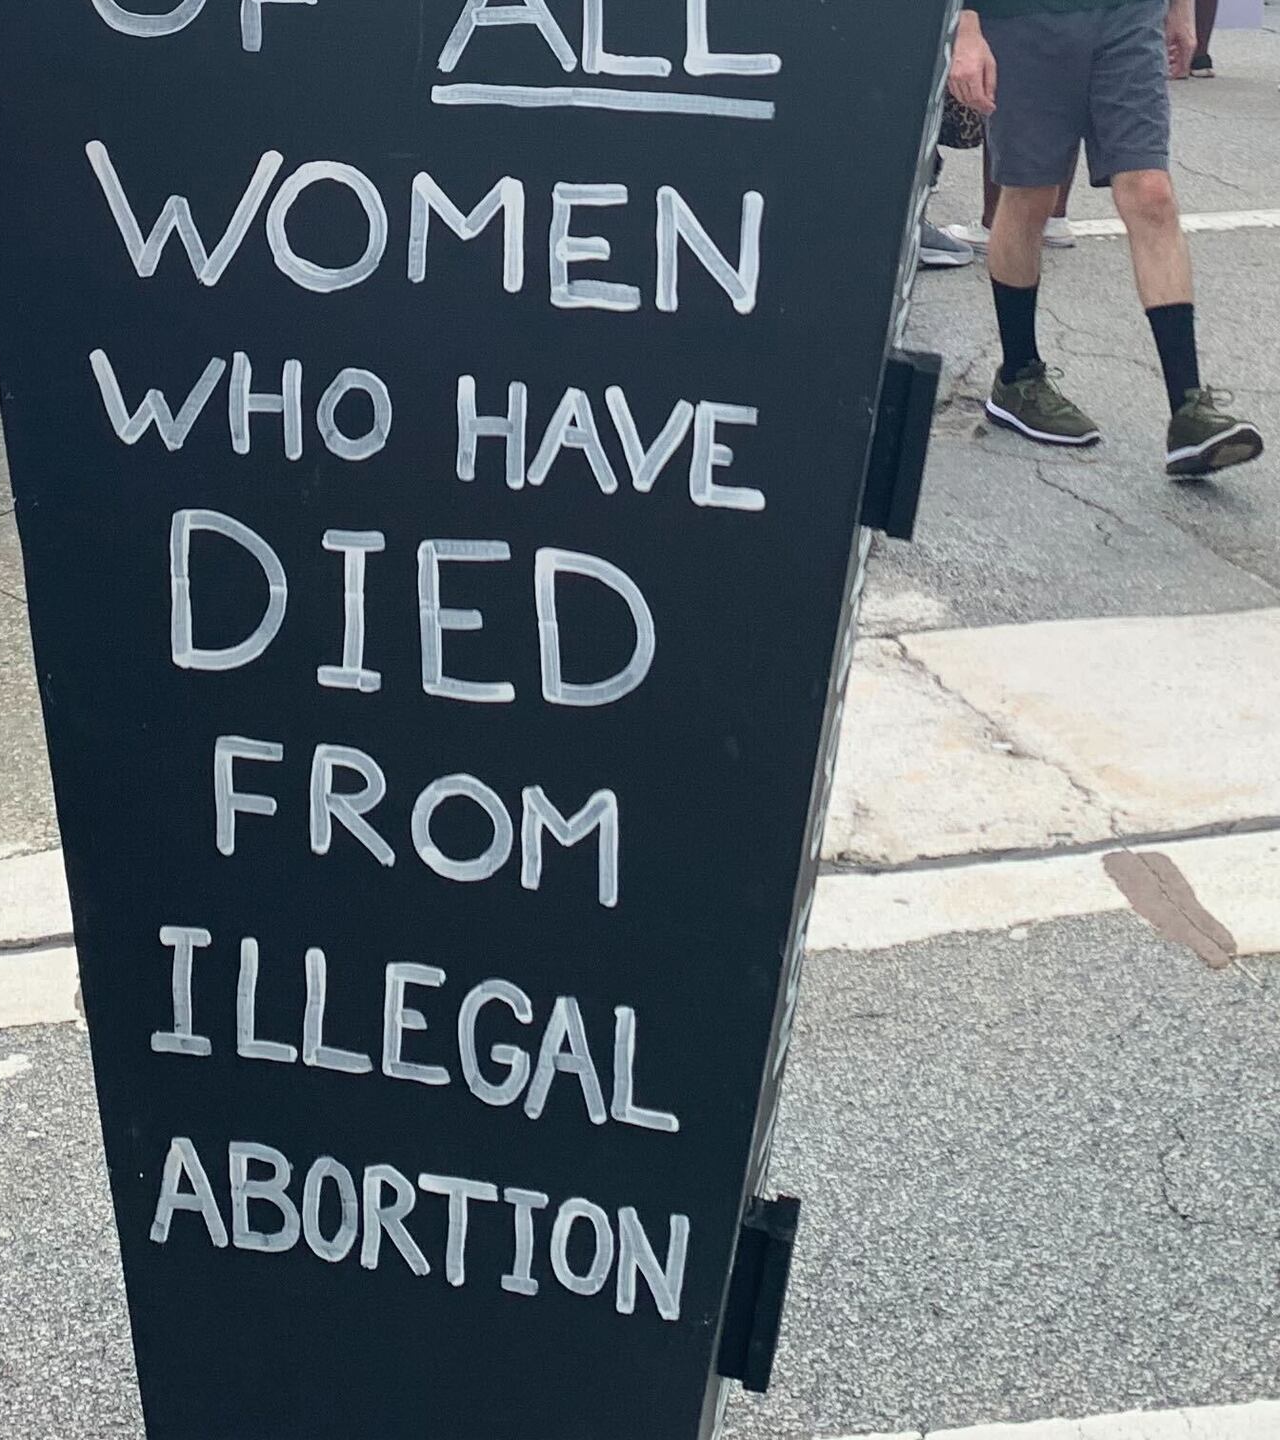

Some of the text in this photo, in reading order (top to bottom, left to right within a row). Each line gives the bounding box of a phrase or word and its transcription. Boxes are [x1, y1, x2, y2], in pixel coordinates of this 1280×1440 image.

[86, 141, 764, 314] WOMEN
[90, 349, 765, 510] WHO HAVE
[170, 510, 655, 706] DIED
[215, 736, 618, 907] FROM
[151, 926, 679, 1133] ILLEGAL
[150, 1138, 689, 1321] ABORTION
